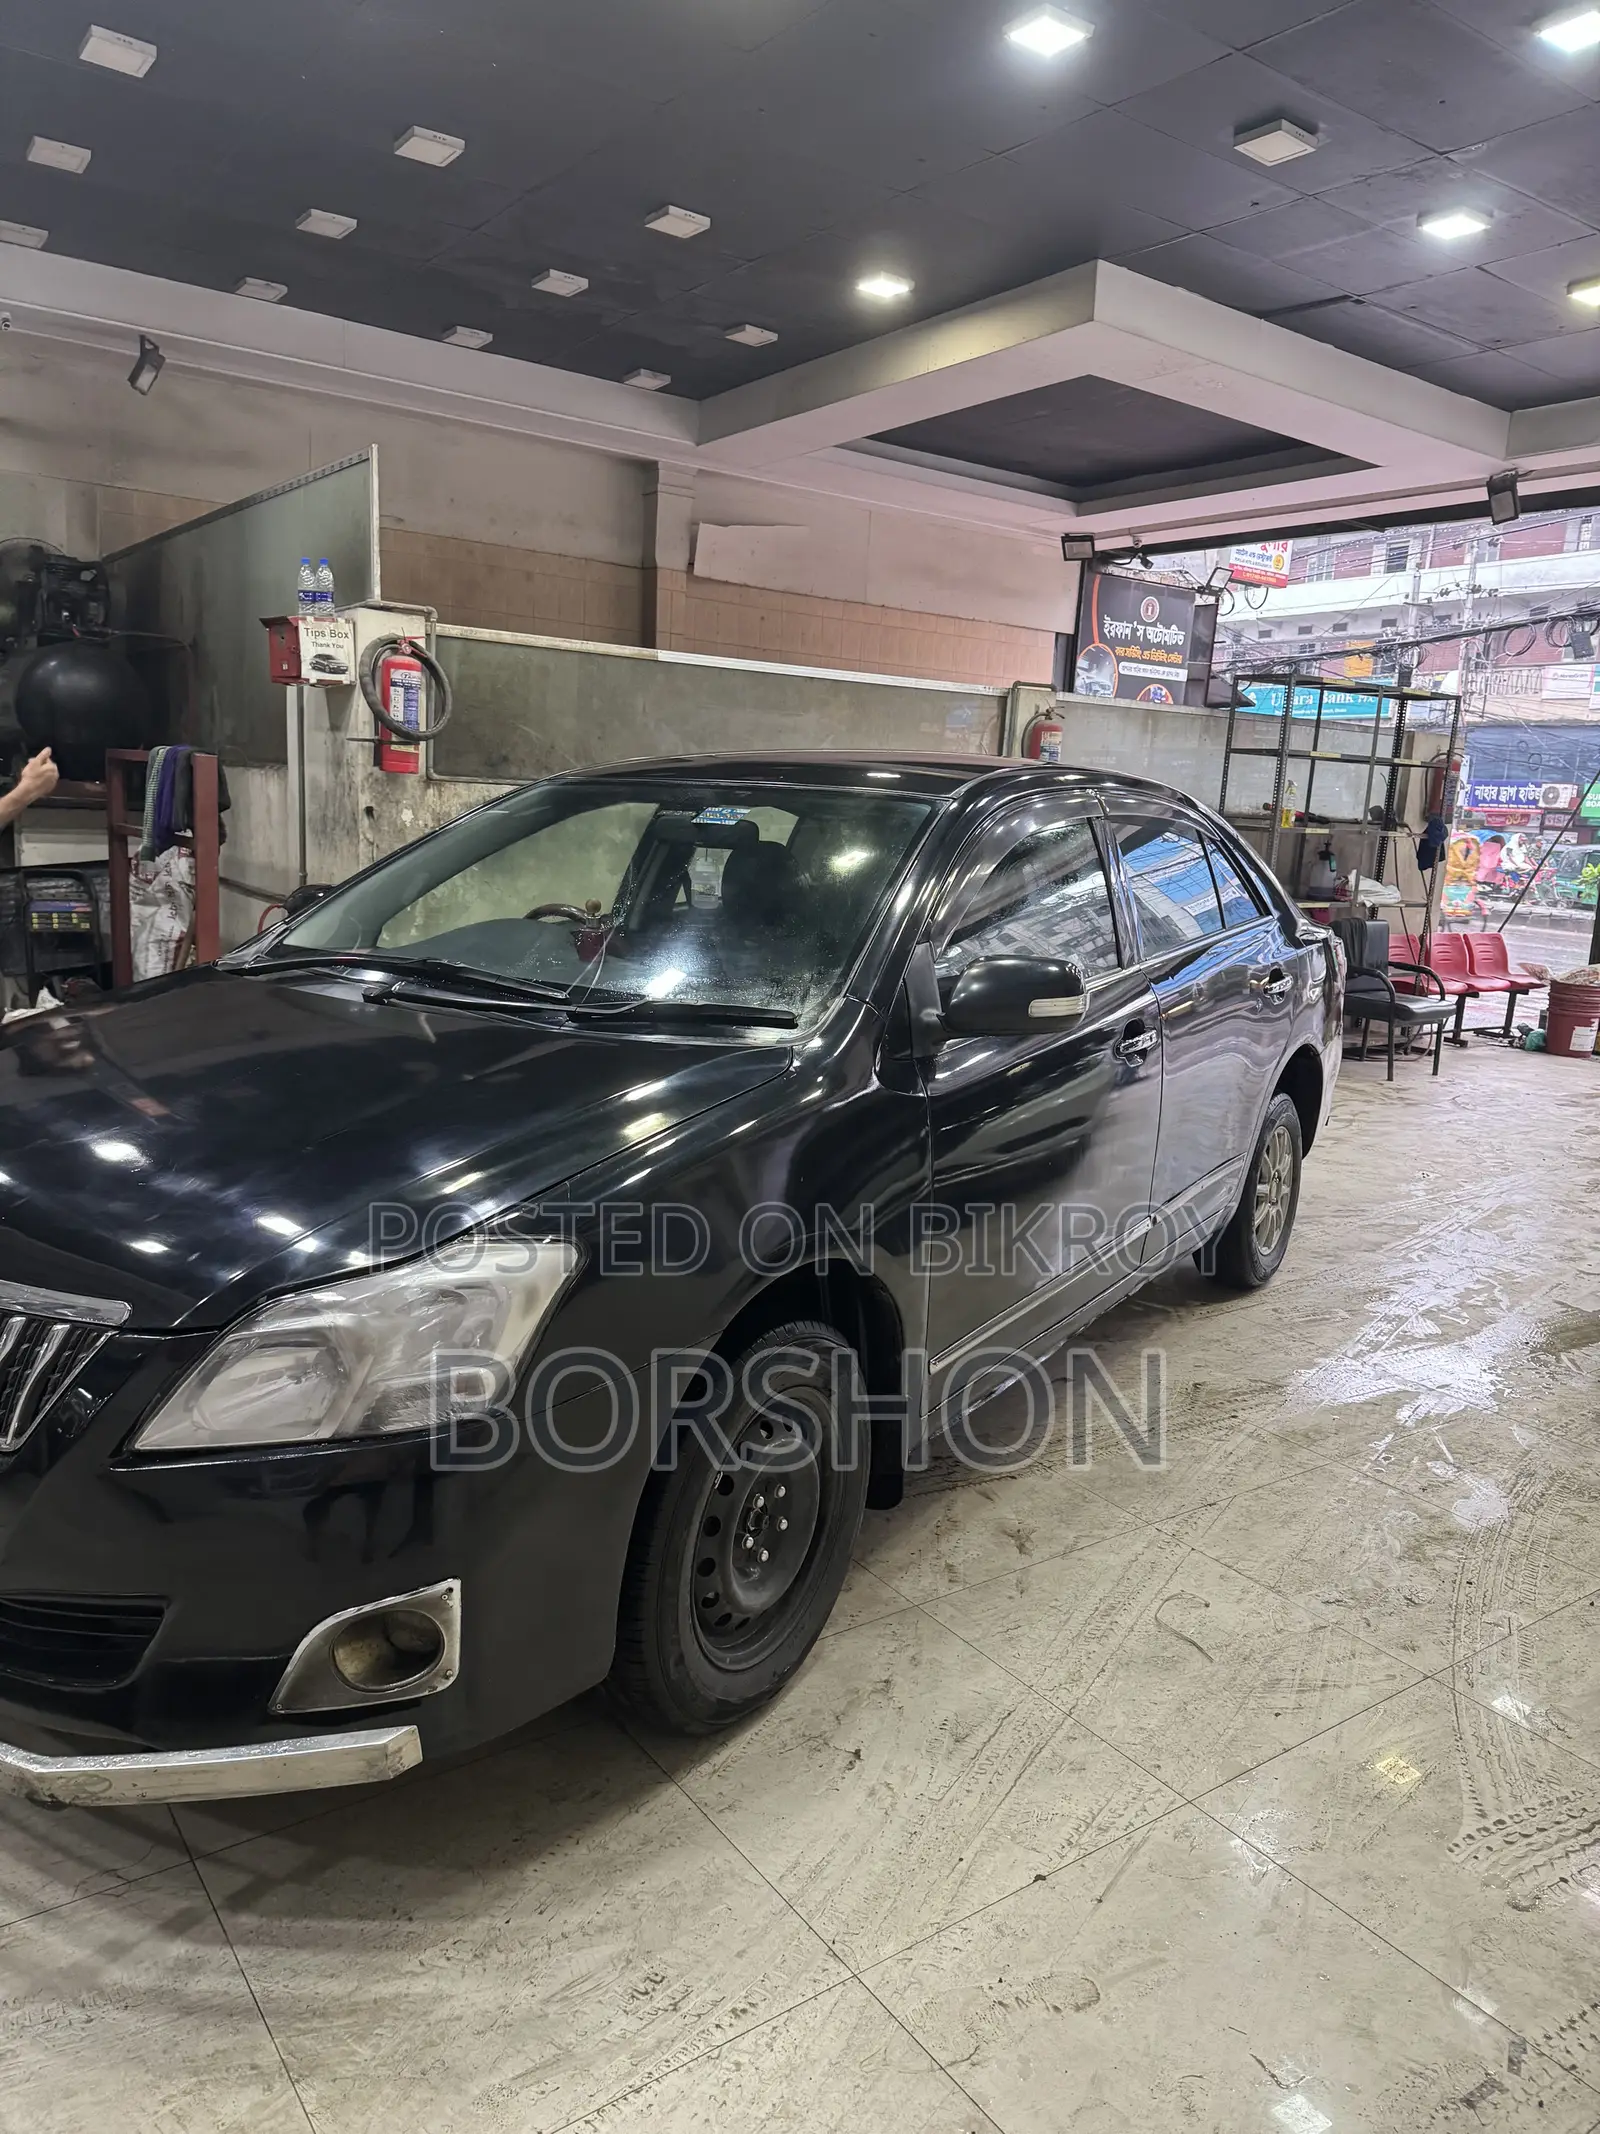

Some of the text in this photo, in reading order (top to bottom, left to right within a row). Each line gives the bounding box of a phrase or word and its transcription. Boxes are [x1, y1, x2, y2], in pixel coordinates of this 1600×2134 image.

[303, 627, 350, 639] Tips Box
[1271, 692, 1313, 706] Uara
[1474, 784, 1498, 802] নাহার
